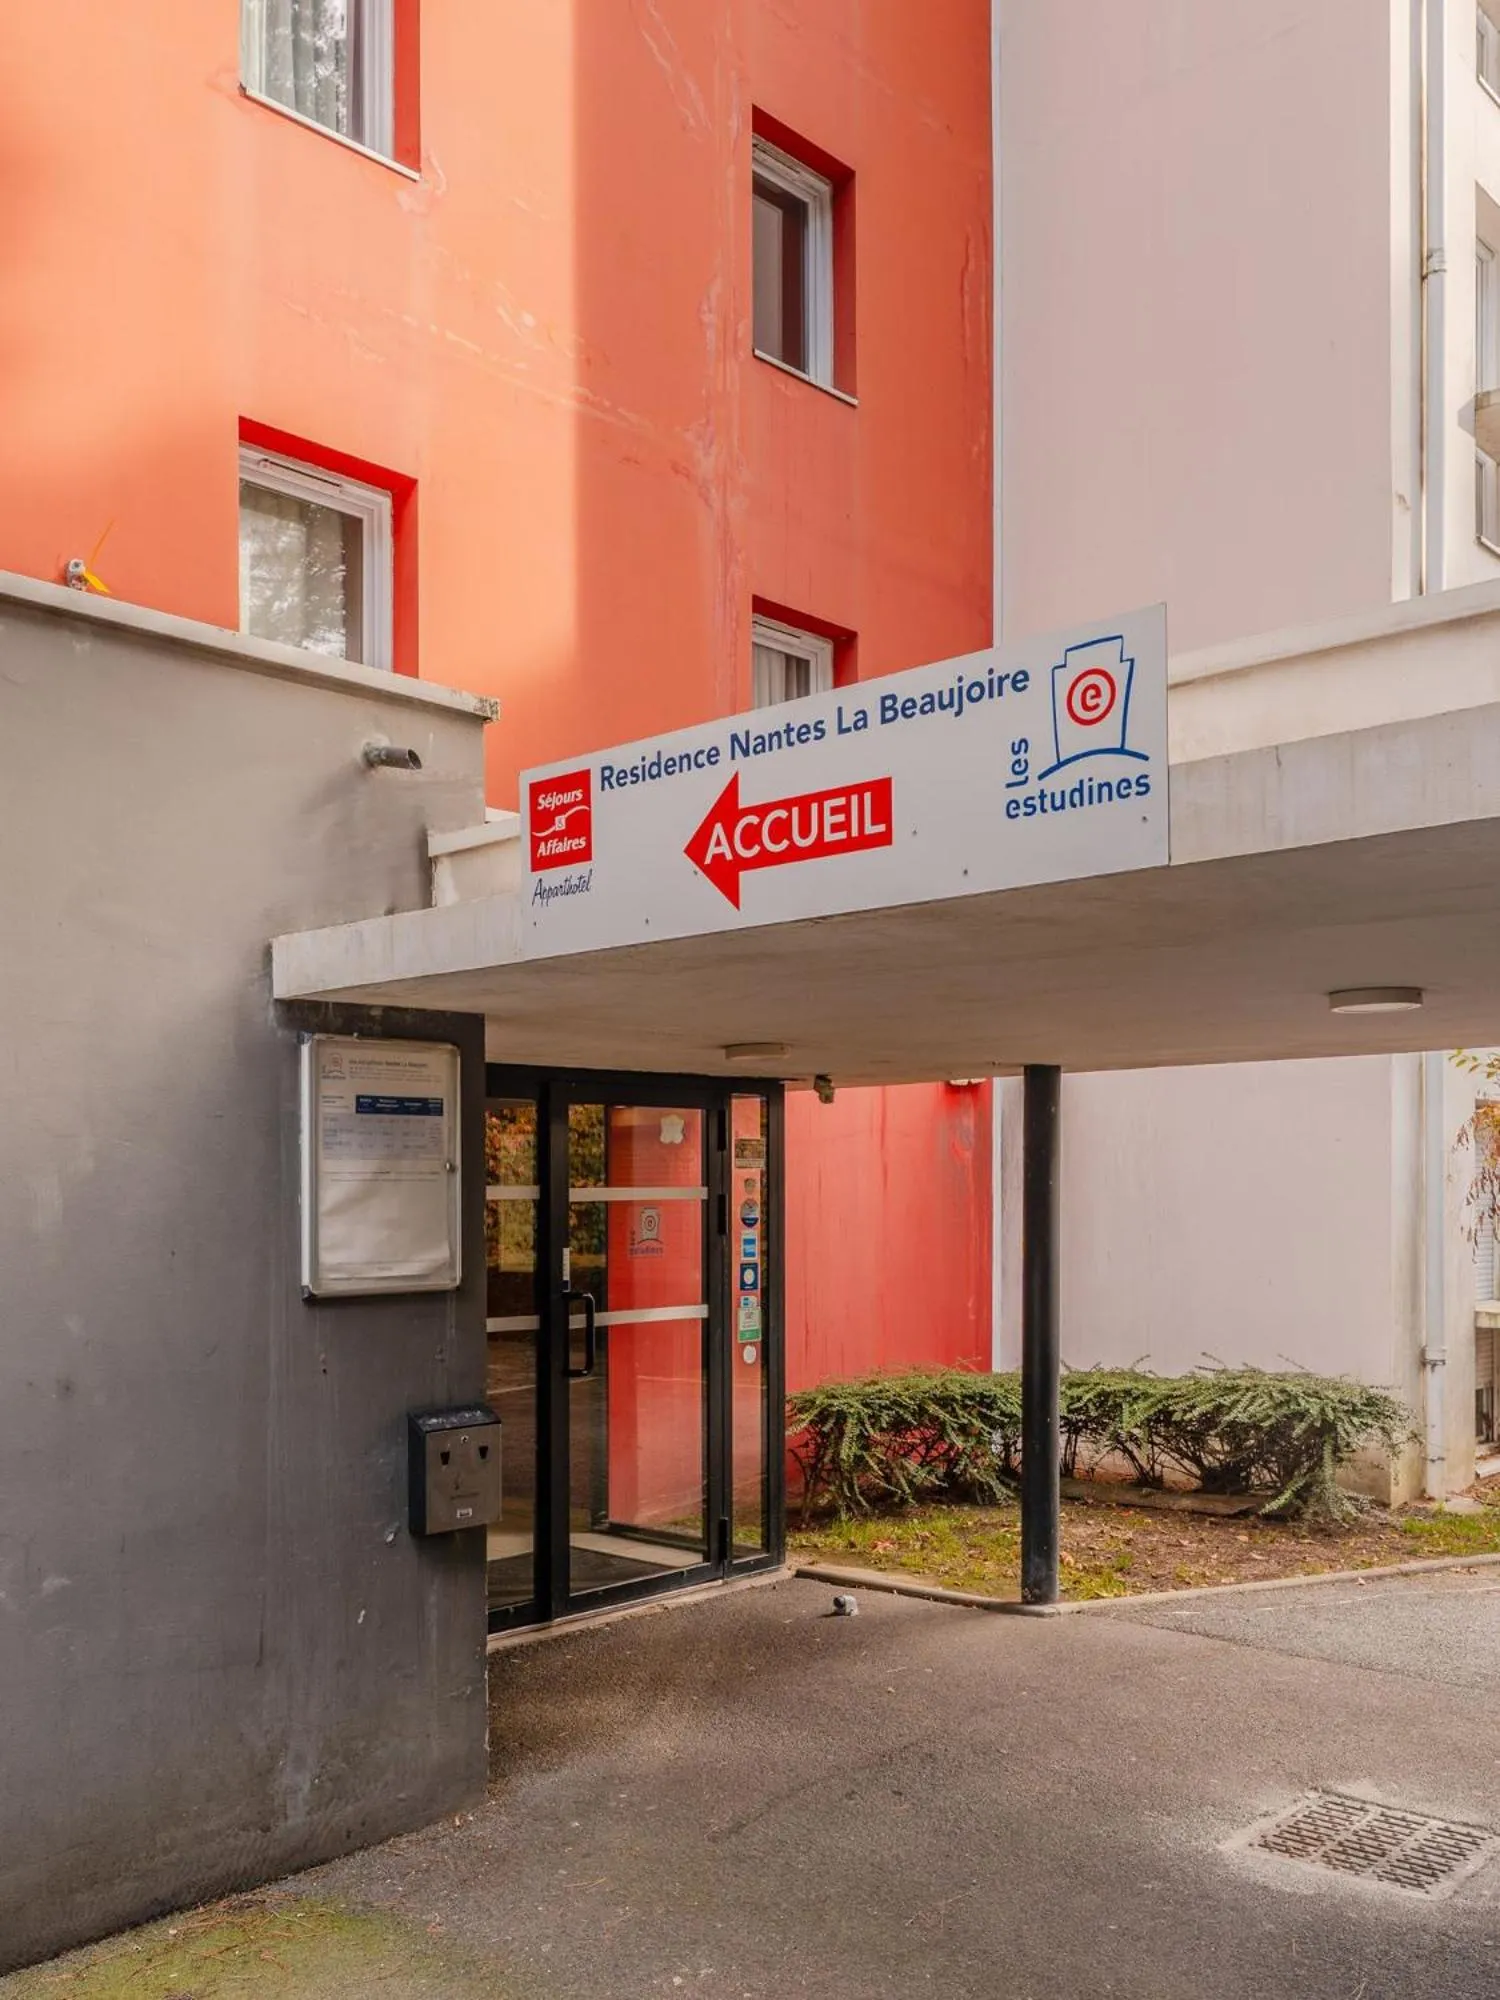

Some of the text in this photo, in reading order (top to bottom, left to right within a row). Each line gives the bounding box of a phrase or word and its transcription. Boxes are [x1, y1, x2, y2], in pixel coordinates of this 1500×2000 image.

[1080, 683, 1102, 712] e
[600, 667, 1031, 791] Residence Nantes La Beaujoire
[1005, 737, 1029, 789] les
[537, 789, 583, 811] Séjours
[1005, 773, 1151, 819] estudines
[537, 836, 586, 858] Affaires
[704, 791, 887, 864] ACCUEIL
